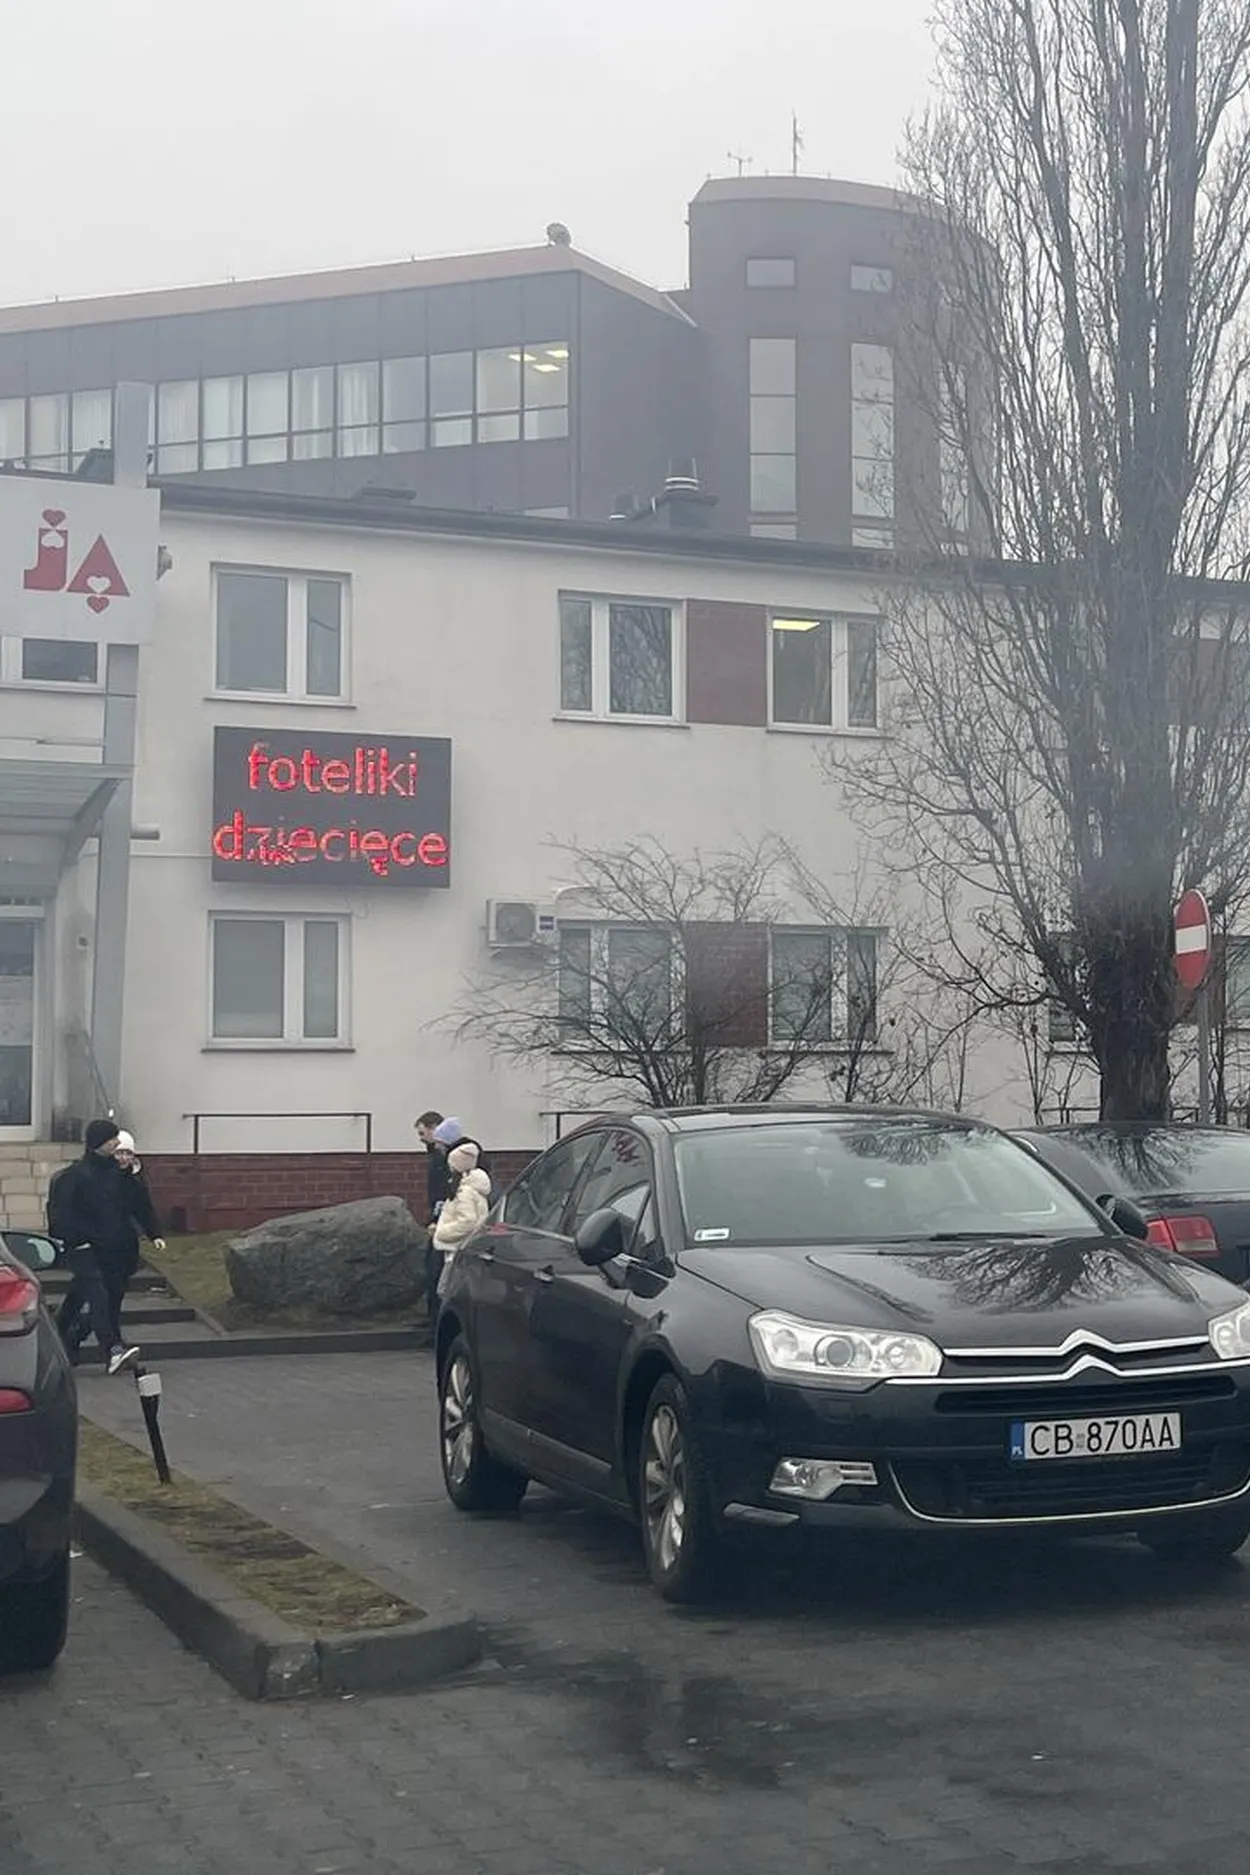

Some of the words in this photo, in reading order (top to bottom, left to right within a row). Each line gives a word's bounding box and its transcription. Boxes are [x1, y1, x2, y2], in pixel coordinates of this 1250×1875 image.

[248, 741, 418, 797] foteliki
[1030, 1424, 1074, 1456] CB
[1086, 1416, 1175, 1452] 870AA
